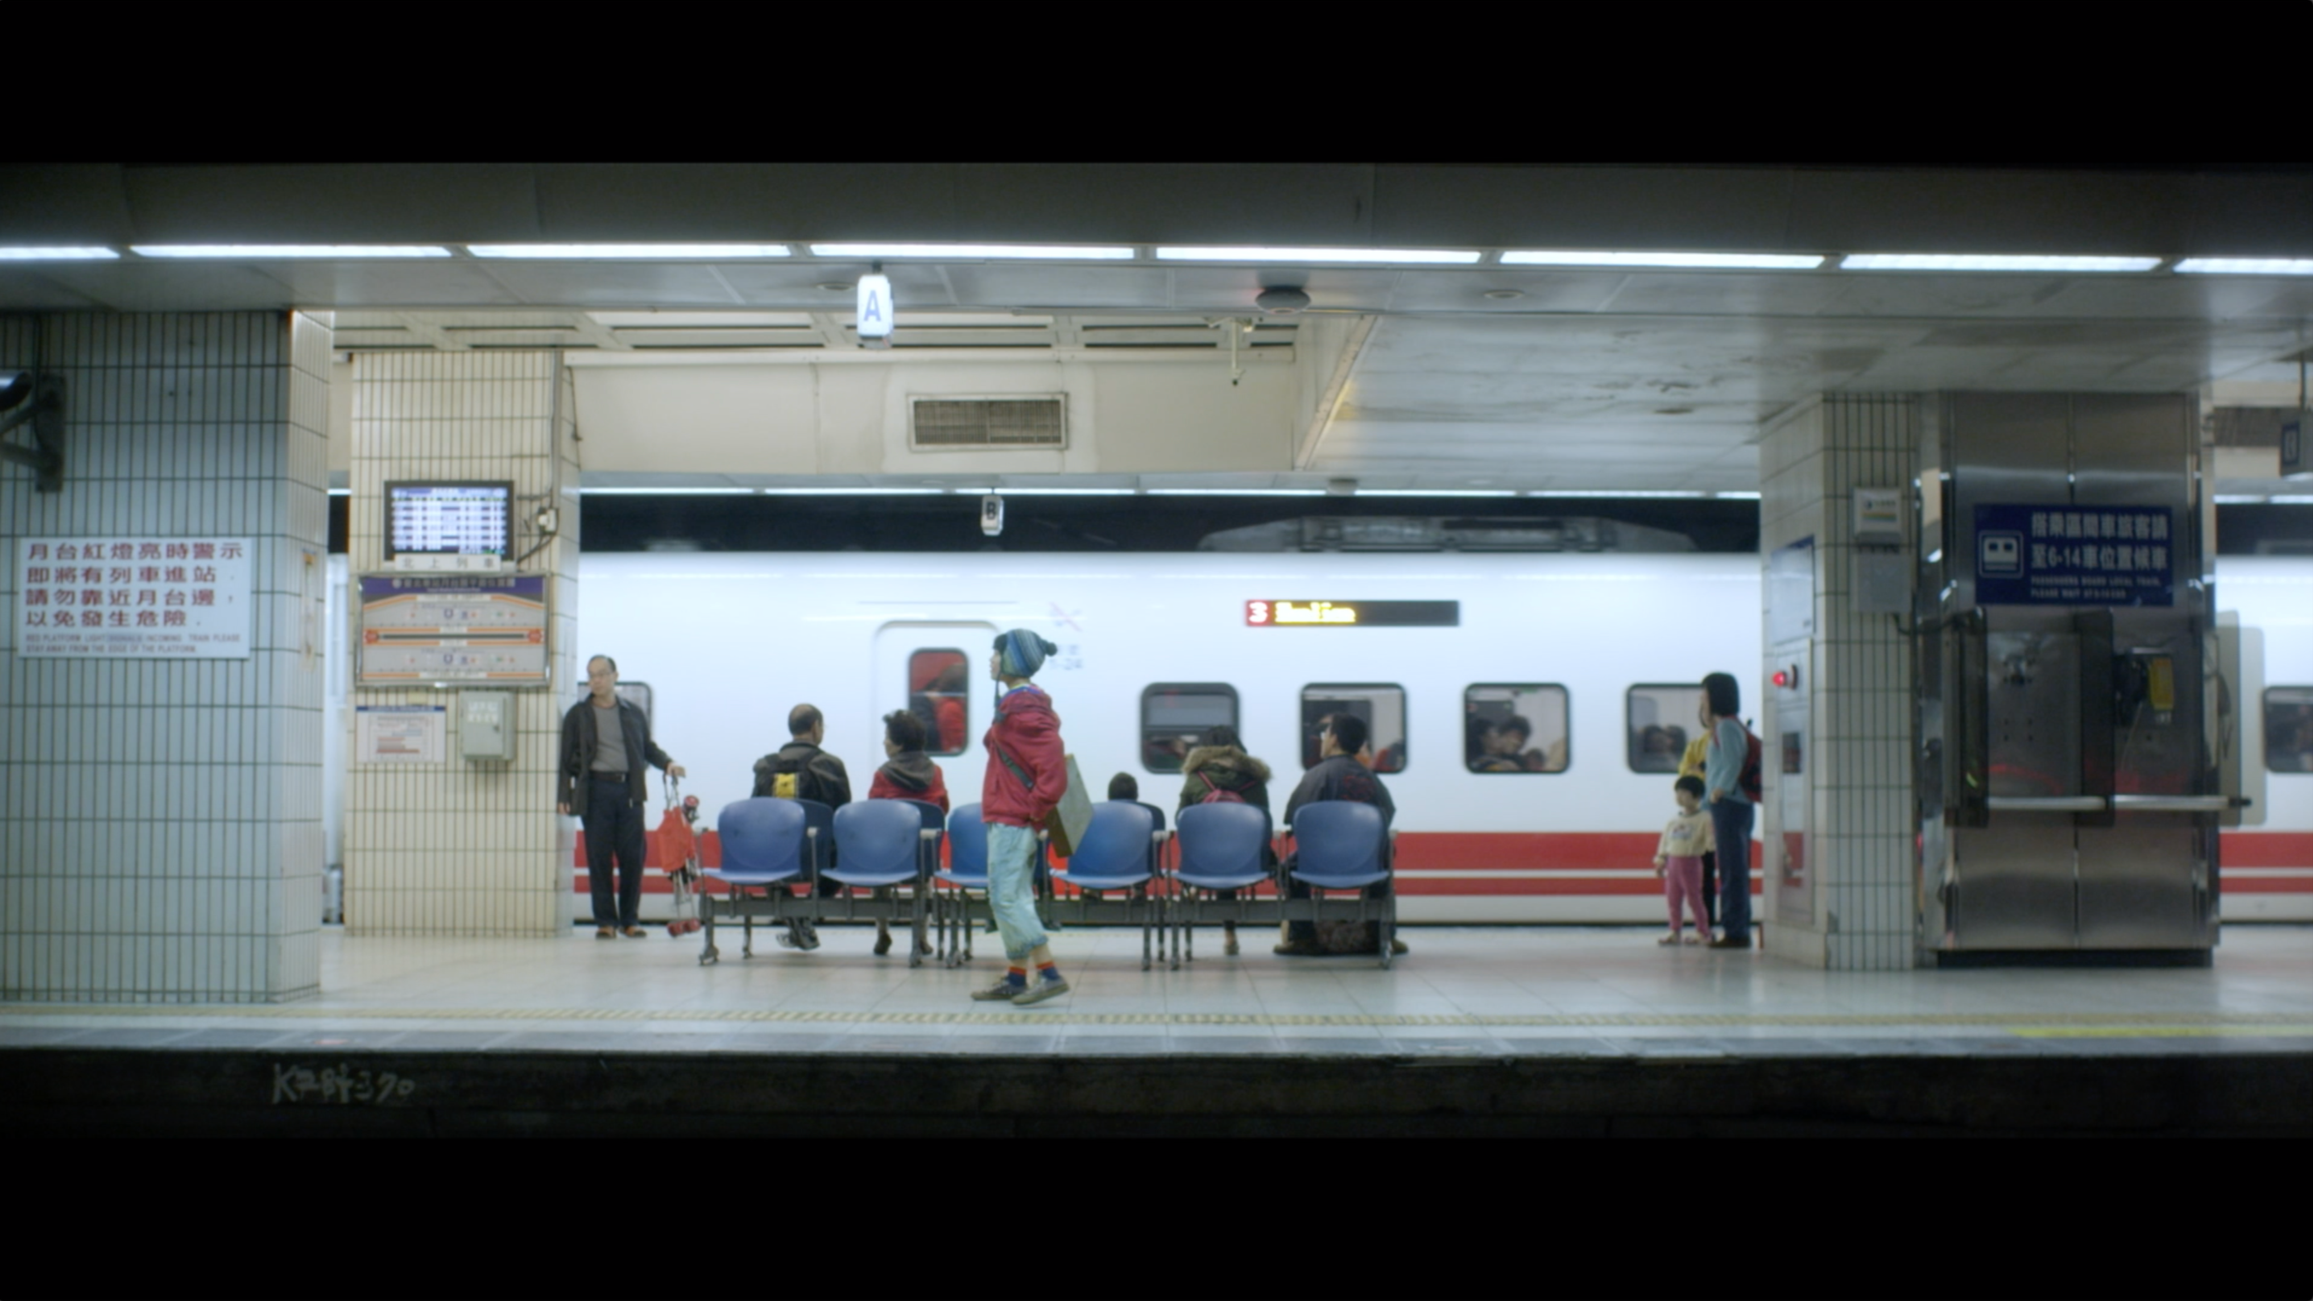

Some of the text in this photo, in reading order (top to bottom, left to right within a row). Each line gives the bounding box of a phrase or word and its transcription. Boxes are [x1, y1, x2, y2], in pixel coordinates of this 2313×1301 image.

[864, 289, 881, 322] A
[986, 501, 996, 520] B
[28, 541, 243, 561] 月台紅燈亮時警示
[403, 557, 493, 569] 北上列車
[1249, 603, 1267, 622] 3
[43, 633, 81, 643] PLATFORM
[189, 633, 209, 643] TRAIN
[213, 633, 240, 643] PLEASE
